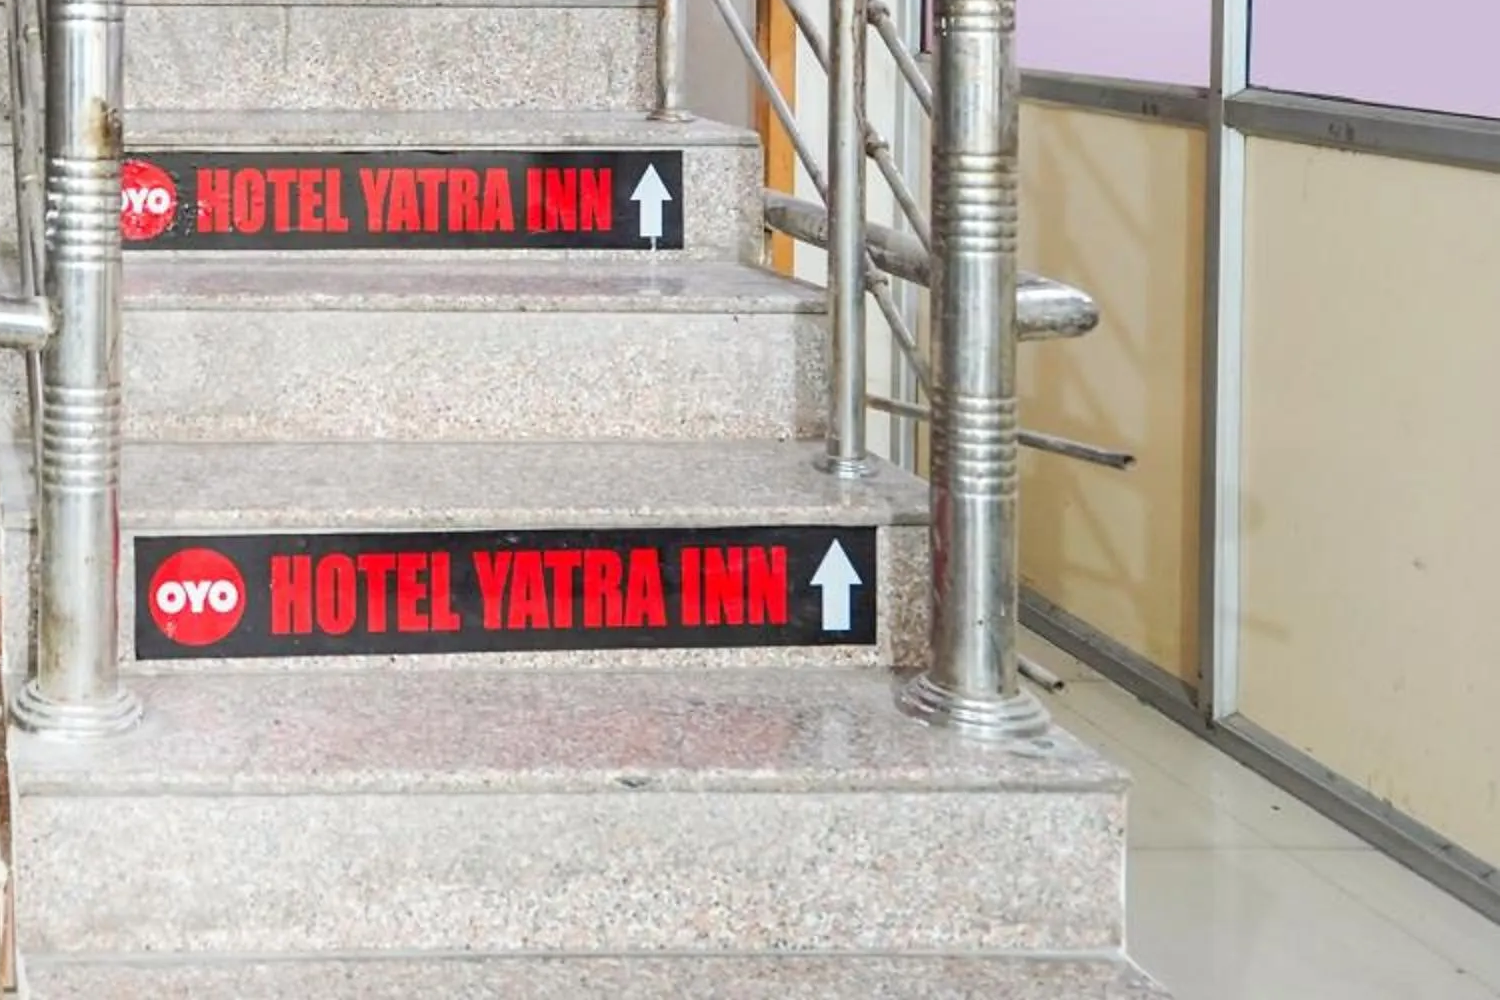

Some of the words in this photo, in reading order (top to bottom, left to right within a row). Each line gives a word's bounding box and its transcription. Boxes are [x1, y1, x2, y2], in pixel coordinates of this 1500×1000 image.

[197, 168, 348, 233] HOTEL
[359, 168, 514, 232] YATRA
[527, 168, 611, 231] INN
[156, 582, 238, 614] OYO
[270, 551, 460, 635] HOTEL
[472, 549, 667, 632] YATRA
[681, 546, 788, 626] INN
